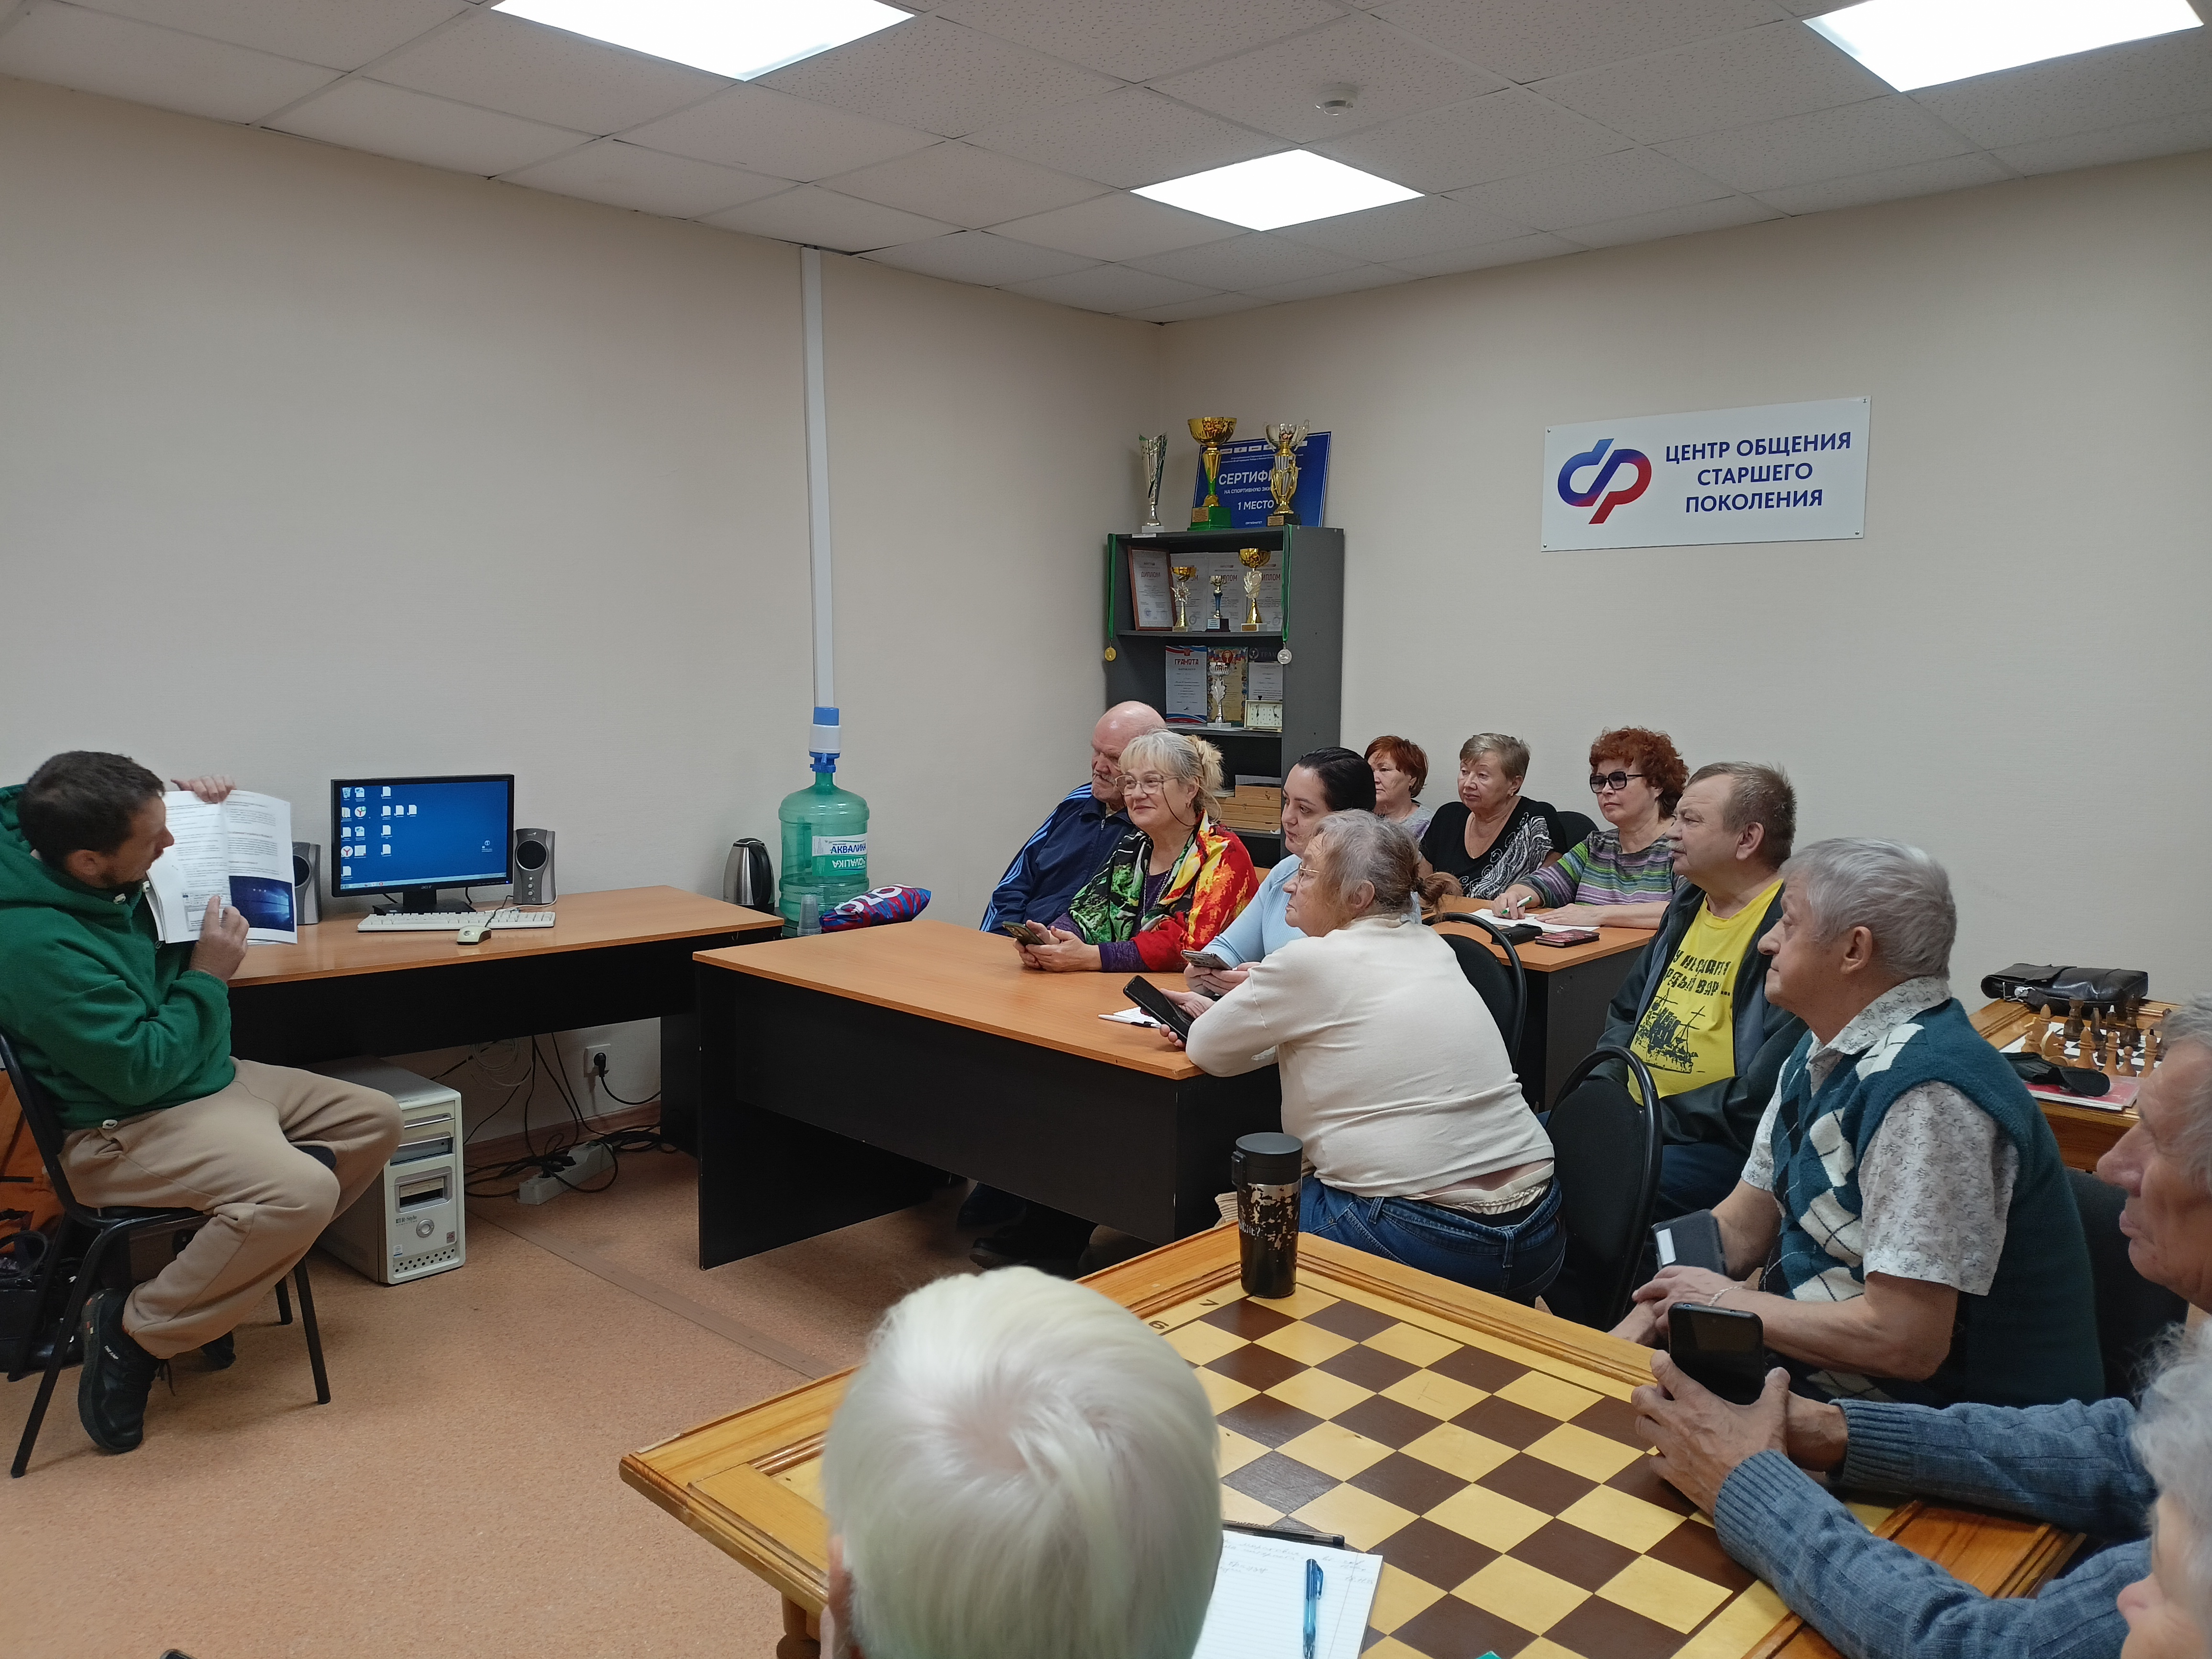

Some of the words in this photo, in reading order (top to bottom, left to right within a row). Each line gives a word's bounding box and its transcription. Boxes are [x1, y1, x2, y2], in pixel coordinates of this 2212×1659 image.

[1666, 442, 1730, 465] ЦЕНТР
[1736, 432, 1851, 458] ОБЩЕНИЯ
[1697, 463, 1813, 486] СТАРШЕГО
[1238, 502, 1241, 510] 1
[1244, 499, 1274, 510] МЕСТО
[1686, 489, 1823, 513] ПОКОЛЕНИЯ
